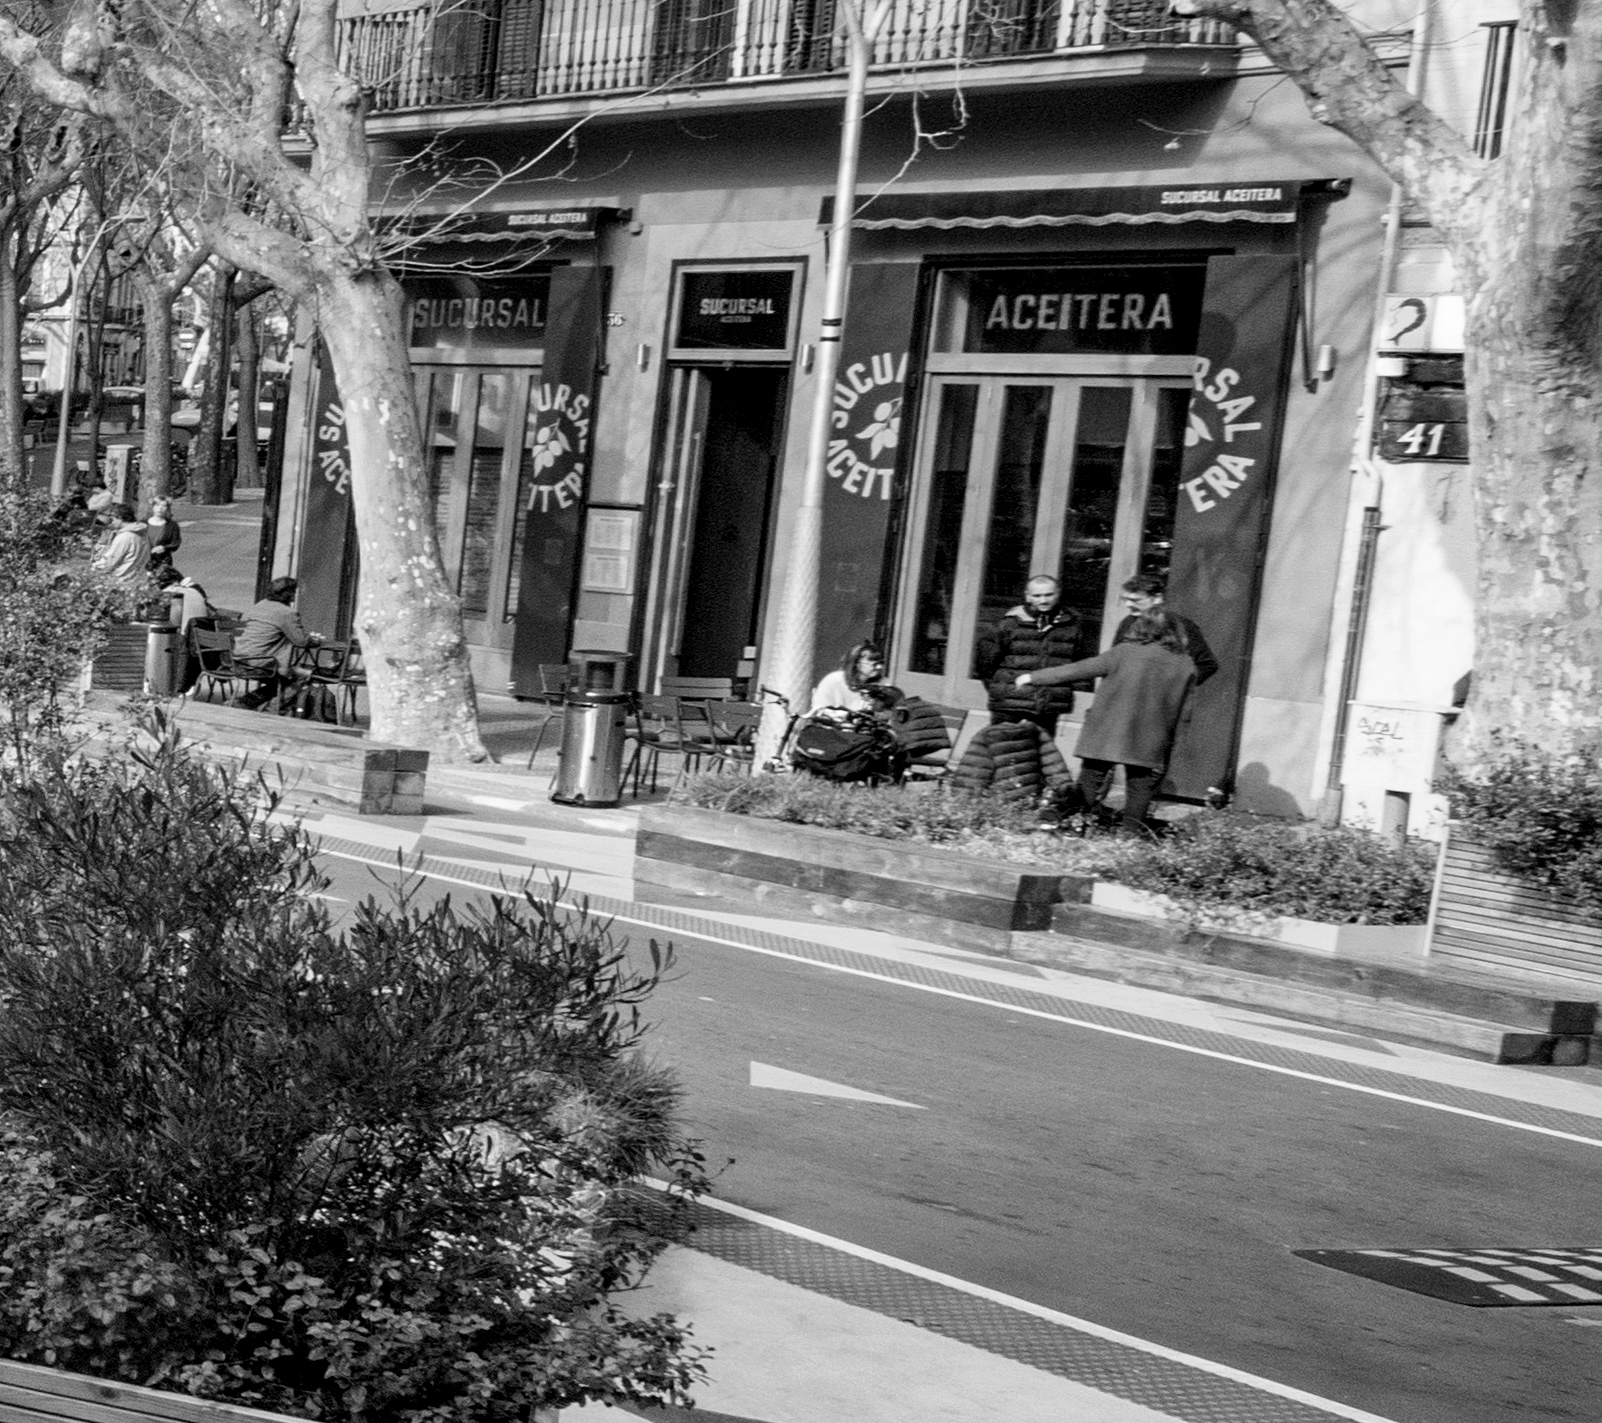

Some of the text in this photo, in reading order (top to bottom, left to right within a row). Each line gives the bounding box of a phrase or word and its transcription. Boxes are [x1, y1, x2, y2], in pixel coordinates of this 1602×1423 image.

[1160, 188, 1282, 204] SUCURSAL ACEITERA
[507, 214, 547, 226] SUCURSAL
[414, 297, 545, 329] SUCURSAL
[699, 297, 776, 316] SUCURSAL
[986, 292, 1173, 330] ACEITERA
[1396, 422, 1446, 456] 41
